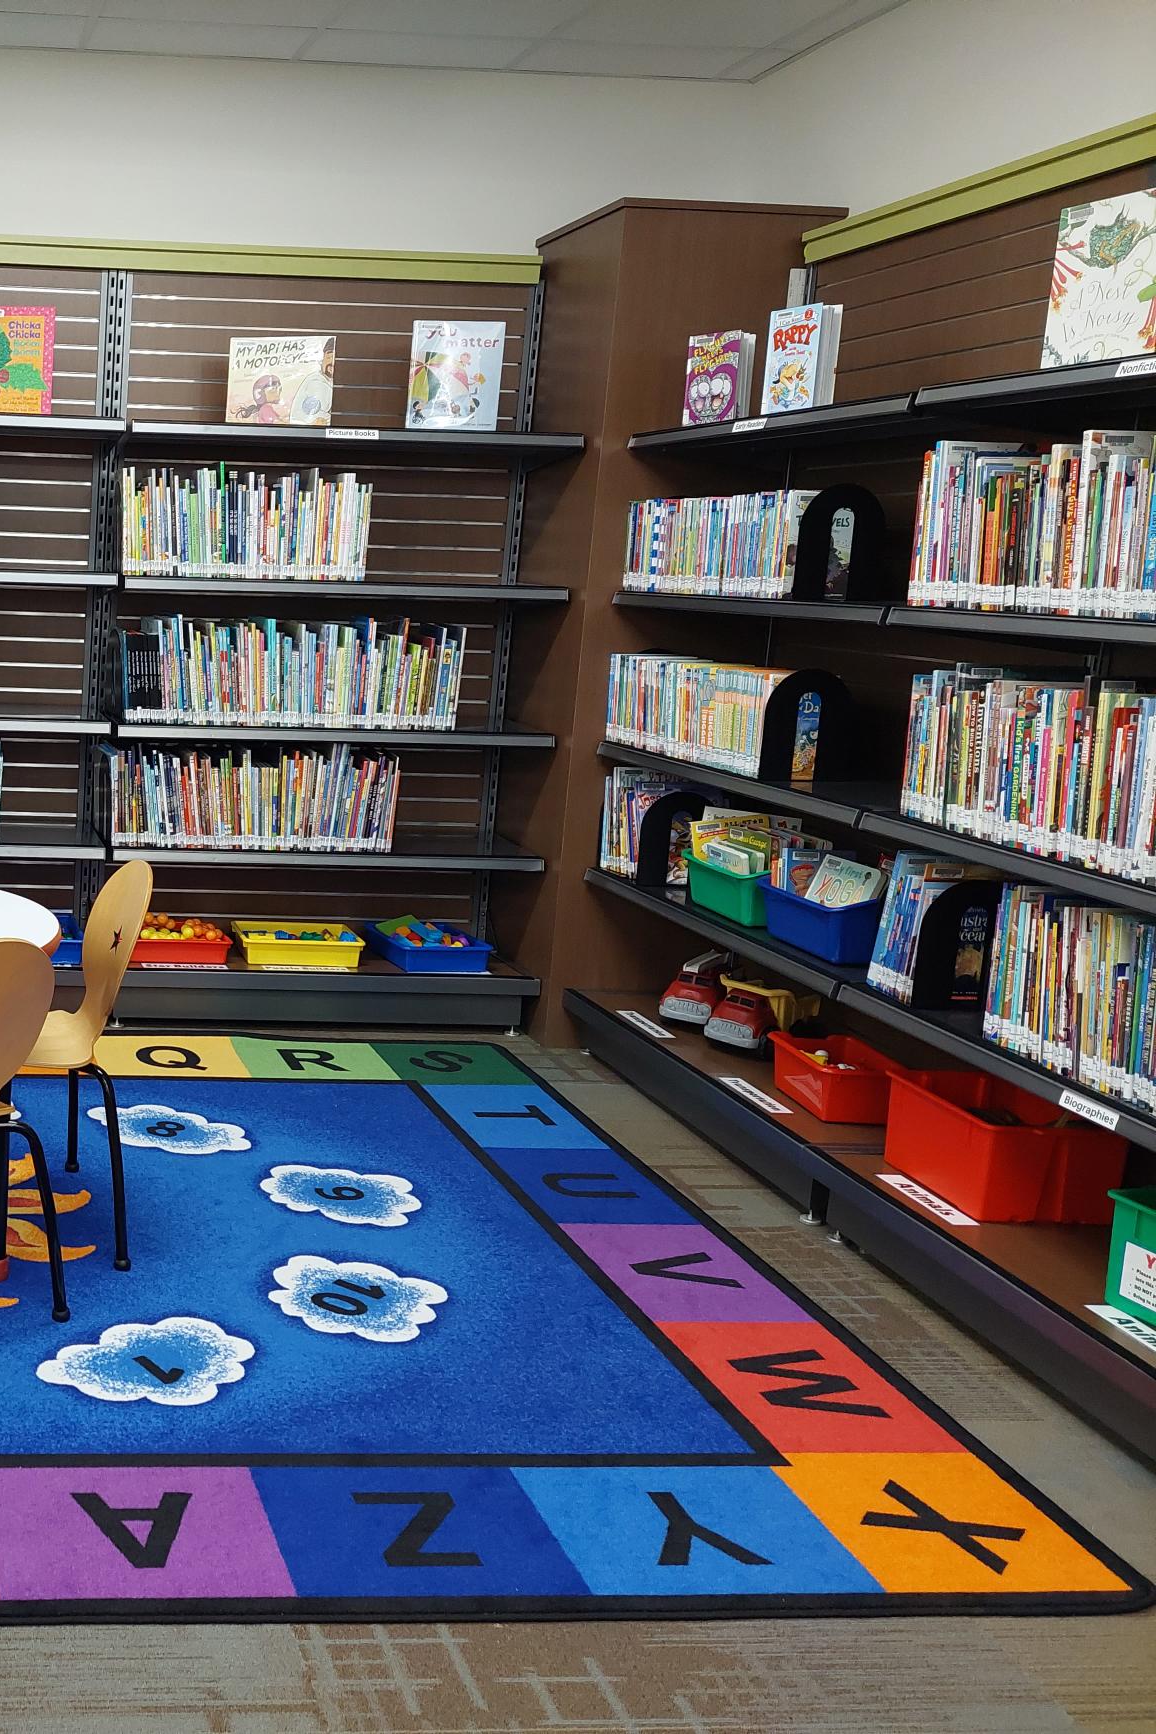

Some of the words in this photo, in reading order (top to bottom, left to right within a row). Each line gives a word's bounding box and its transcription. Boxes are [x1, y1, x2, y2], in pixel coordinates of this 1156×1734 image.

[8, 321, 41, 330] Chicka
[8, 330, 41, 339] Chicka
[773, 323, 818, 352] RAPPY
[1080, 309, 1138, 337] Noisy
[236, 347, 254, 358] MY
[282, 340, 306, 352] HAS
[974, 703, 986, 774] Inventions
[1015, 721, 1024, 743] kid's
[1014, 744, 1024, 764] first
[1010, 767, 1019, 819] GARDENING
[812, 872, 865, 905] YOGA
[135, 1045, 208, 1071] Q
[274, 1048, 350, 1072] R
[408, 1050, 463, 1073] S
[473, 1104, 562, 1126] T
[1064, 1095, 1115, 1126] Biographies
[146, 1120, 186, 1137] 8
[314, 1185, 365, 1201] 9
[542, 1173, 640, 1199] U
[894, 1180, 957, 1218] Animals
[627, 1251, 746, 1289] V
[310, 1278, 387, 1316] 10
[132, 1355, 185, 1384] 1
[726, 1349, 893, 1419] W
[69, 1492, 192, 1569] A
[350, 1491, 483, 1567] Z
[646, 1491, 774, 1566] Y
[860, 1479, 1027, 1576] X
